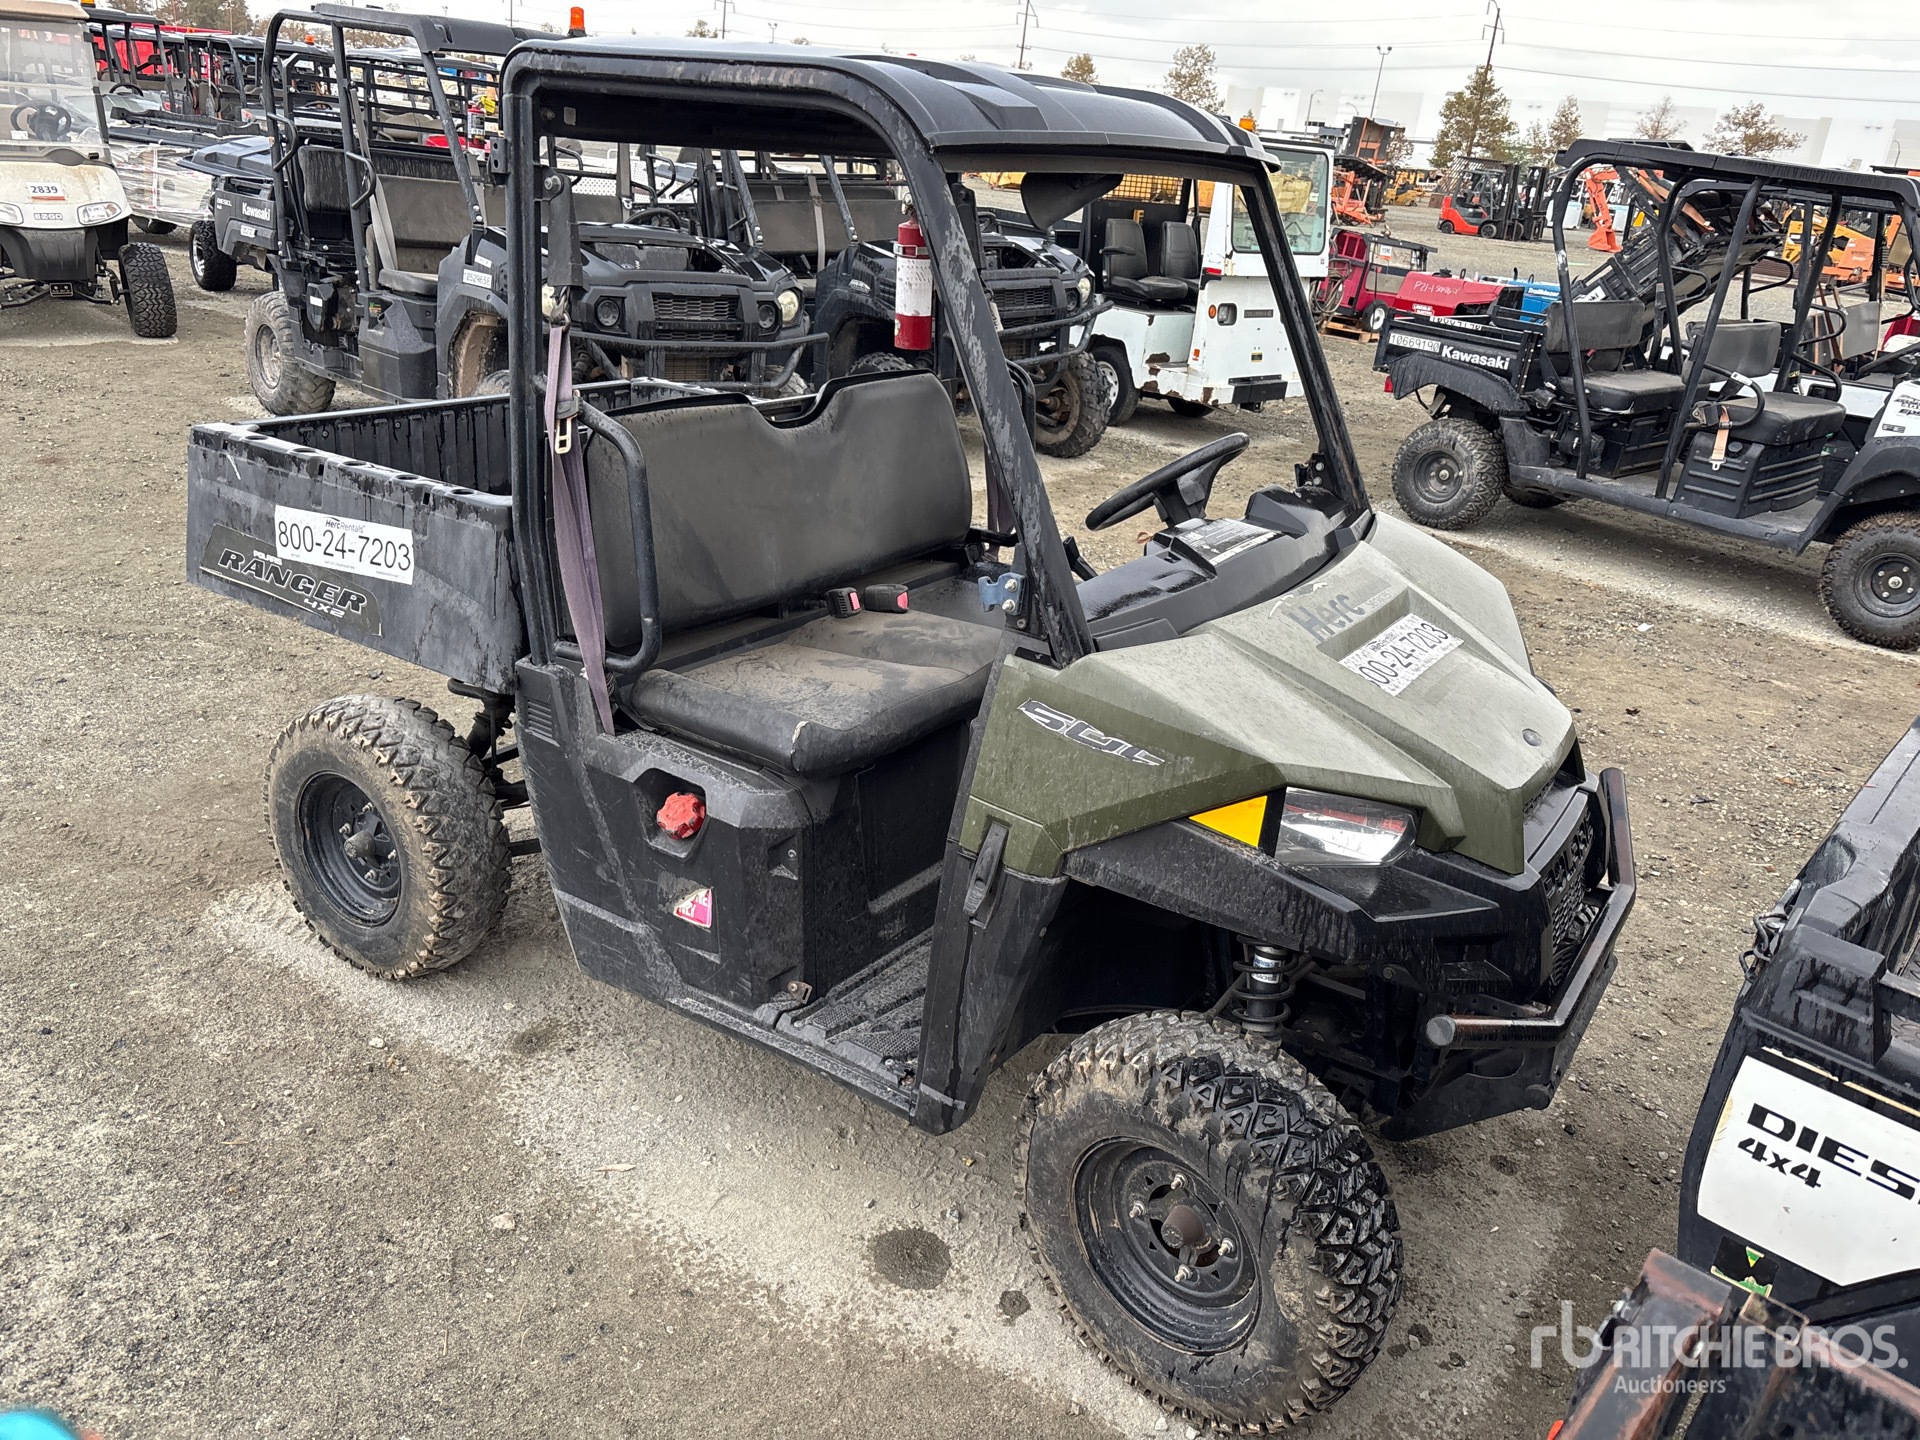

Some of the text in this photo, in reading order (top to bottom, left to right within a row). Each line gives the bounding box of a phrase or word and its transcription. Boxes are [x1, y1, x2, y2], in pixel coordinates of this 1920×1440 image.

[30, 185, 58, 194] 2839
[242, 202, 271, 221] Kawasaki
[1391, 334, 1440, 352] 10669190
[1441, 345, 1510, 370] Kawasaki
[278, 520, 412, 571] 800-24-7203
[218, 548, 367, 614] RANGER
[1370, 622, 1449, 688] 00-24-7203
[1737, 1137, 1821, 1188] 4x4
[1747, 1103, 1920, 1205] DIES
